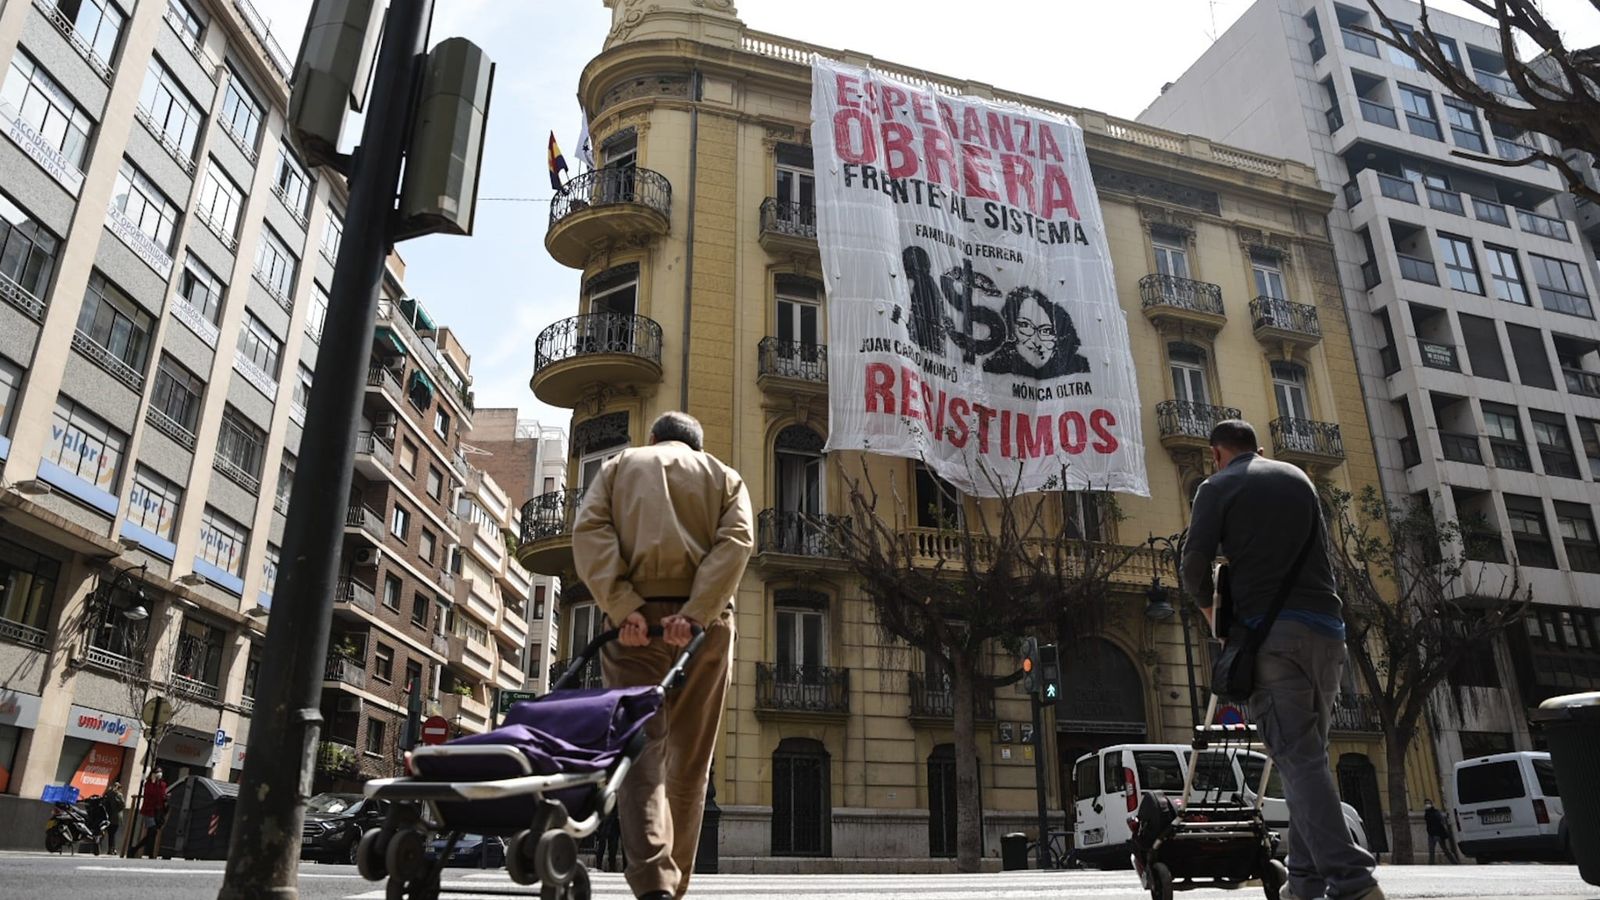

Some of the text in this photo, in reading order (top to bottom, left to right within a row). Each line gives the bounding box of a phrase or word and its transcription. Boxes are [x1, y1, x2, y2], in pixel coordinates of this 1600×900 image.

[836, 75, 1064, 162] ESPERANZA
[10, 128, 63, 182] EN GENERAL
[13, 118, 67, 170] ACCIDENTES
[833, 109, 1080, 221] OBRERA
[843, 163, 1089, 246] FRENTE AL SISTEMA
[121, 217, 170, 268] OPORTUNIDAD
[915, 224, 956, 248] FAMILIA
[976, 244, 1023, 264] FERRERA
[860, 338, 891, 353] JUAN
[865, 362, 1118, 460] RESISTIMOS
[1012, 381, 1093, 401] MÓNICA OLTRA
[53, 425, 108, 469] valora
[131, 488, 167, 519] alora
[200, 528, 236, 557] valora
[78, 714, 127, 736] umivale
